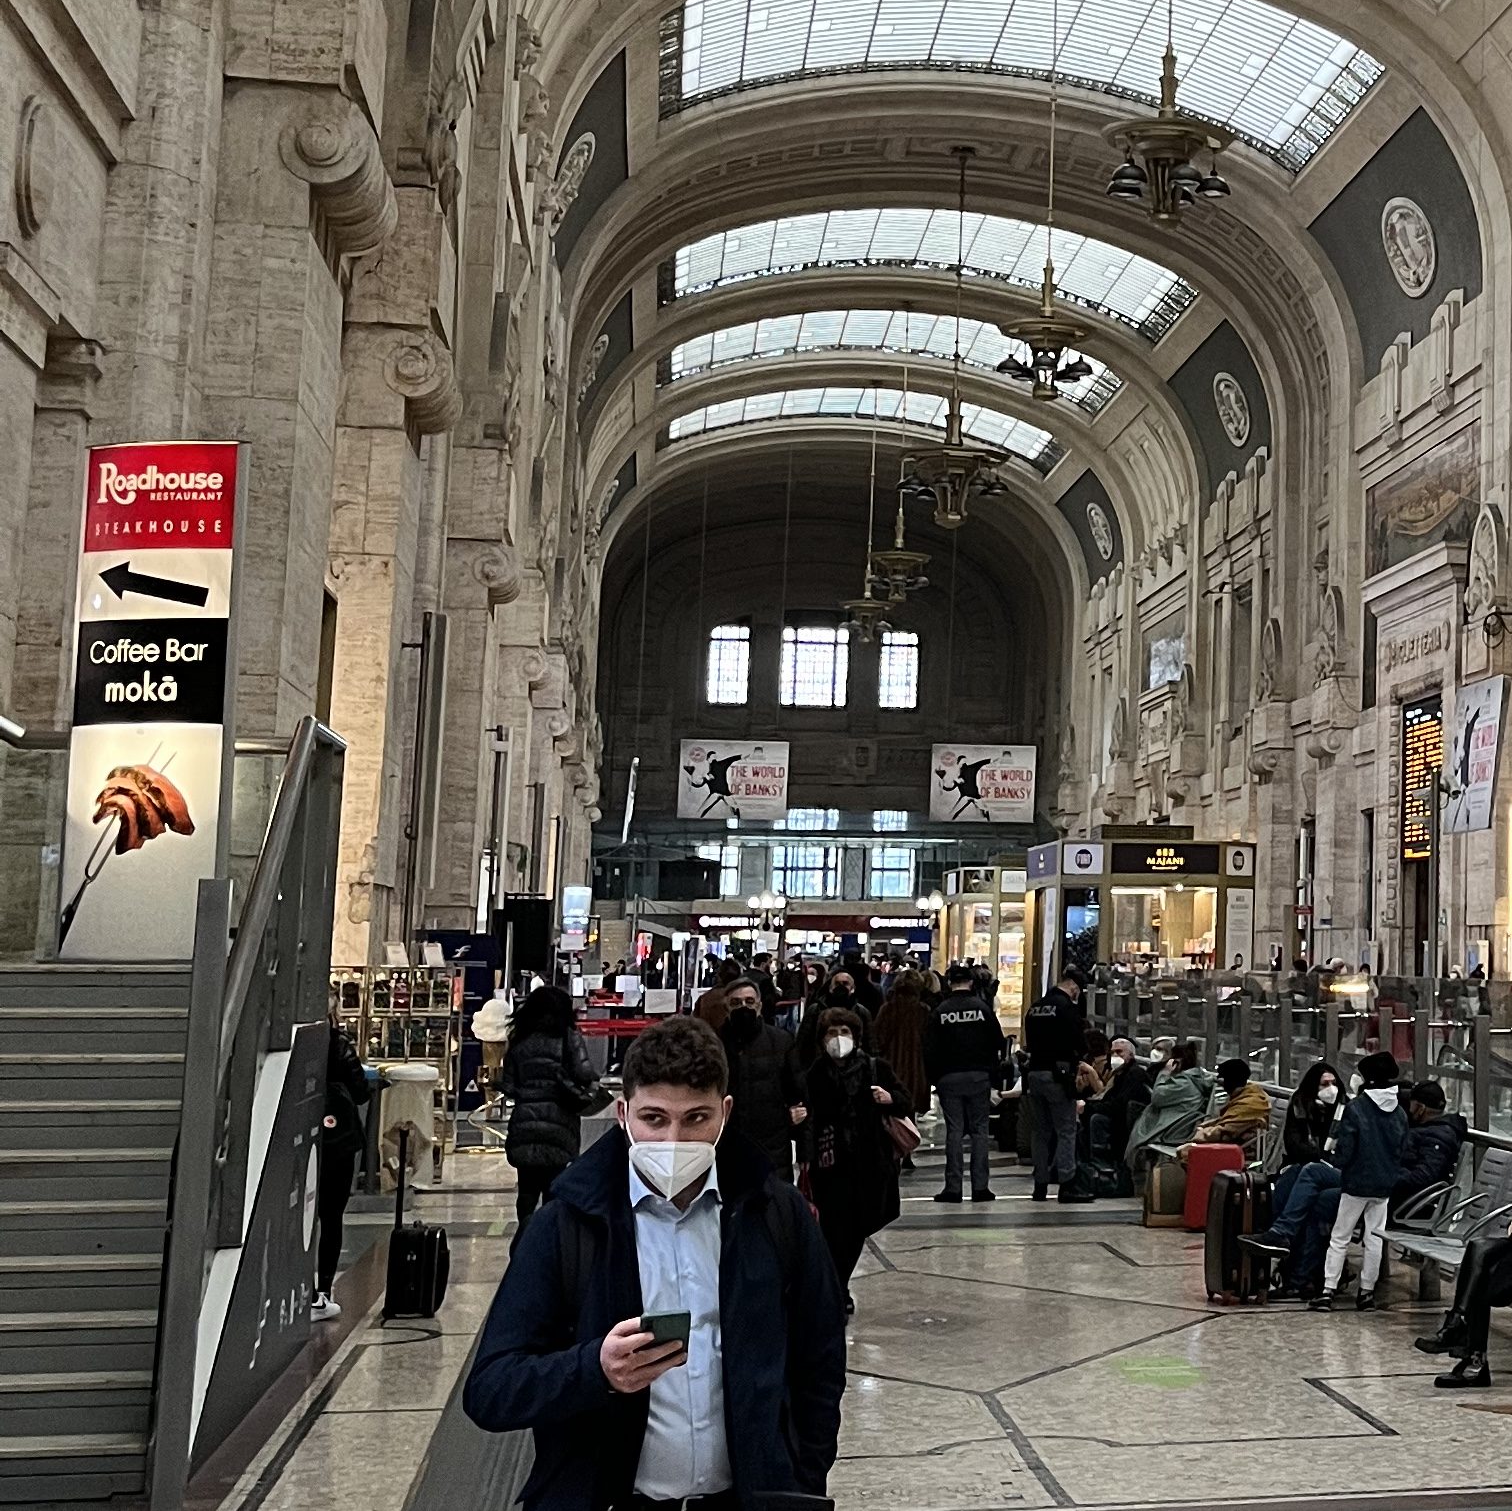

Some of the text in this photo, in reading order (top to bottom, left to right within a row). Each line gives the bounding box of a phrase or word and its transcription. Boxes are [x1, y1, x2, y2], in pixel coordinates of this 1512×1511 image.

[96, 462, 224, 505] Roadhouse
[150, 491, 223, 501] RESTAURANT
[95, 519, 222, 536] STEAKHOUSE
[89, 637, 209, 664] Coffee Bar
[104, 669, 178, 703] mokā
[752, 766, 785, 779] WORLD
[1001, 769, 1033, 782] WORLD
[745, 783, 784, 797] BANKSY
[994, 787, 1032, 800] BANKSY
[940, 1009, 985, 1025] POLIZIA
